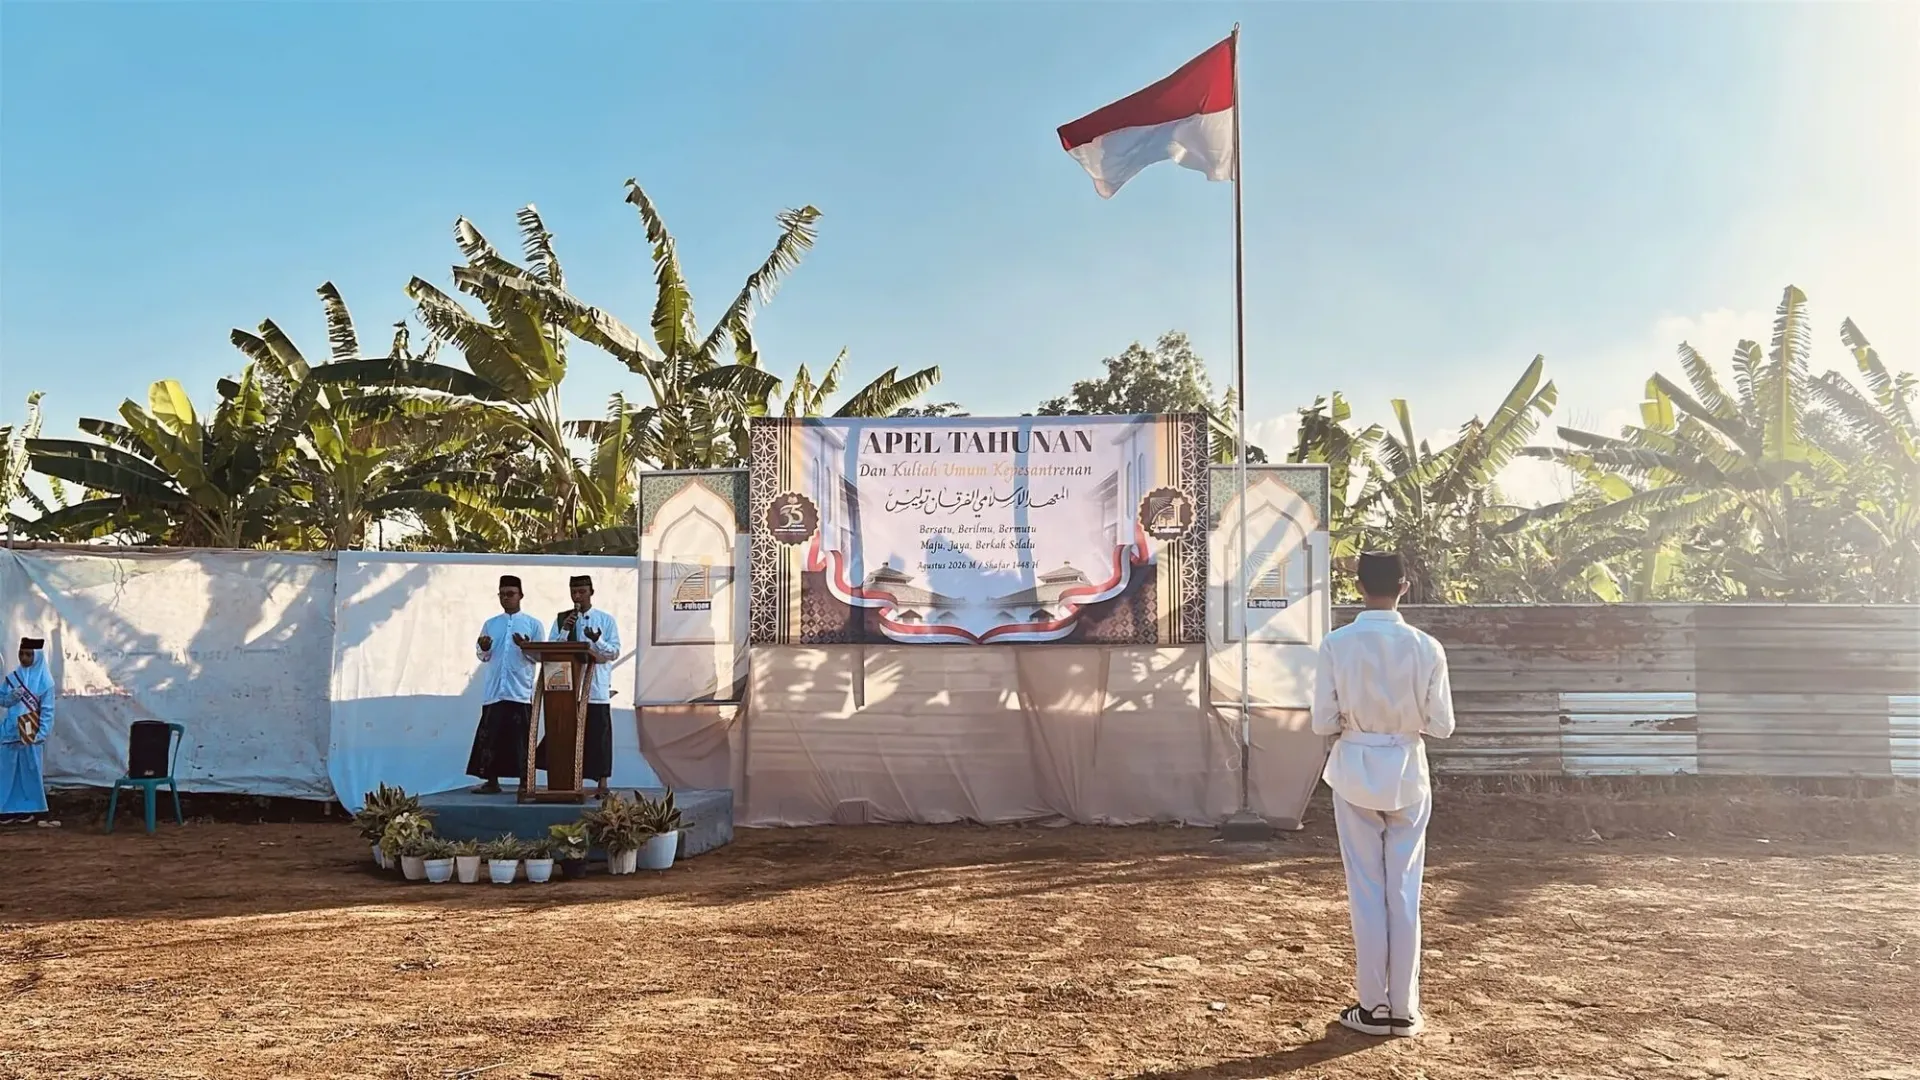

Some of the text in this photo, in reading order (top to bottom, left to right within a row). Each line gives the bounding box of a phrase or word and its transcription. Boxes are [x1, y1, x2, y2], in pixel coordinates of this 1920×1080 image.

[862, 430, 1092, 454] APEL TAHUNAN
[860, 460, 1092, 483] Dan Kuliah Umum Kepesantrenan
[780, 503, 804, 528] 35
[920, 522, 1037, 535] Bersatu, Berilmu, Bermutu
[920, 539, 1036, 554] Maju, Jaya, Berkah Selalu
[917, 561, 946, 572] Agustus
[948, 561, 967, 570] 2026
[968, 561, 978, 570] M
[984, 559, 1011, 572] Shafar
[1013, 561, 1030, 569] 1448
